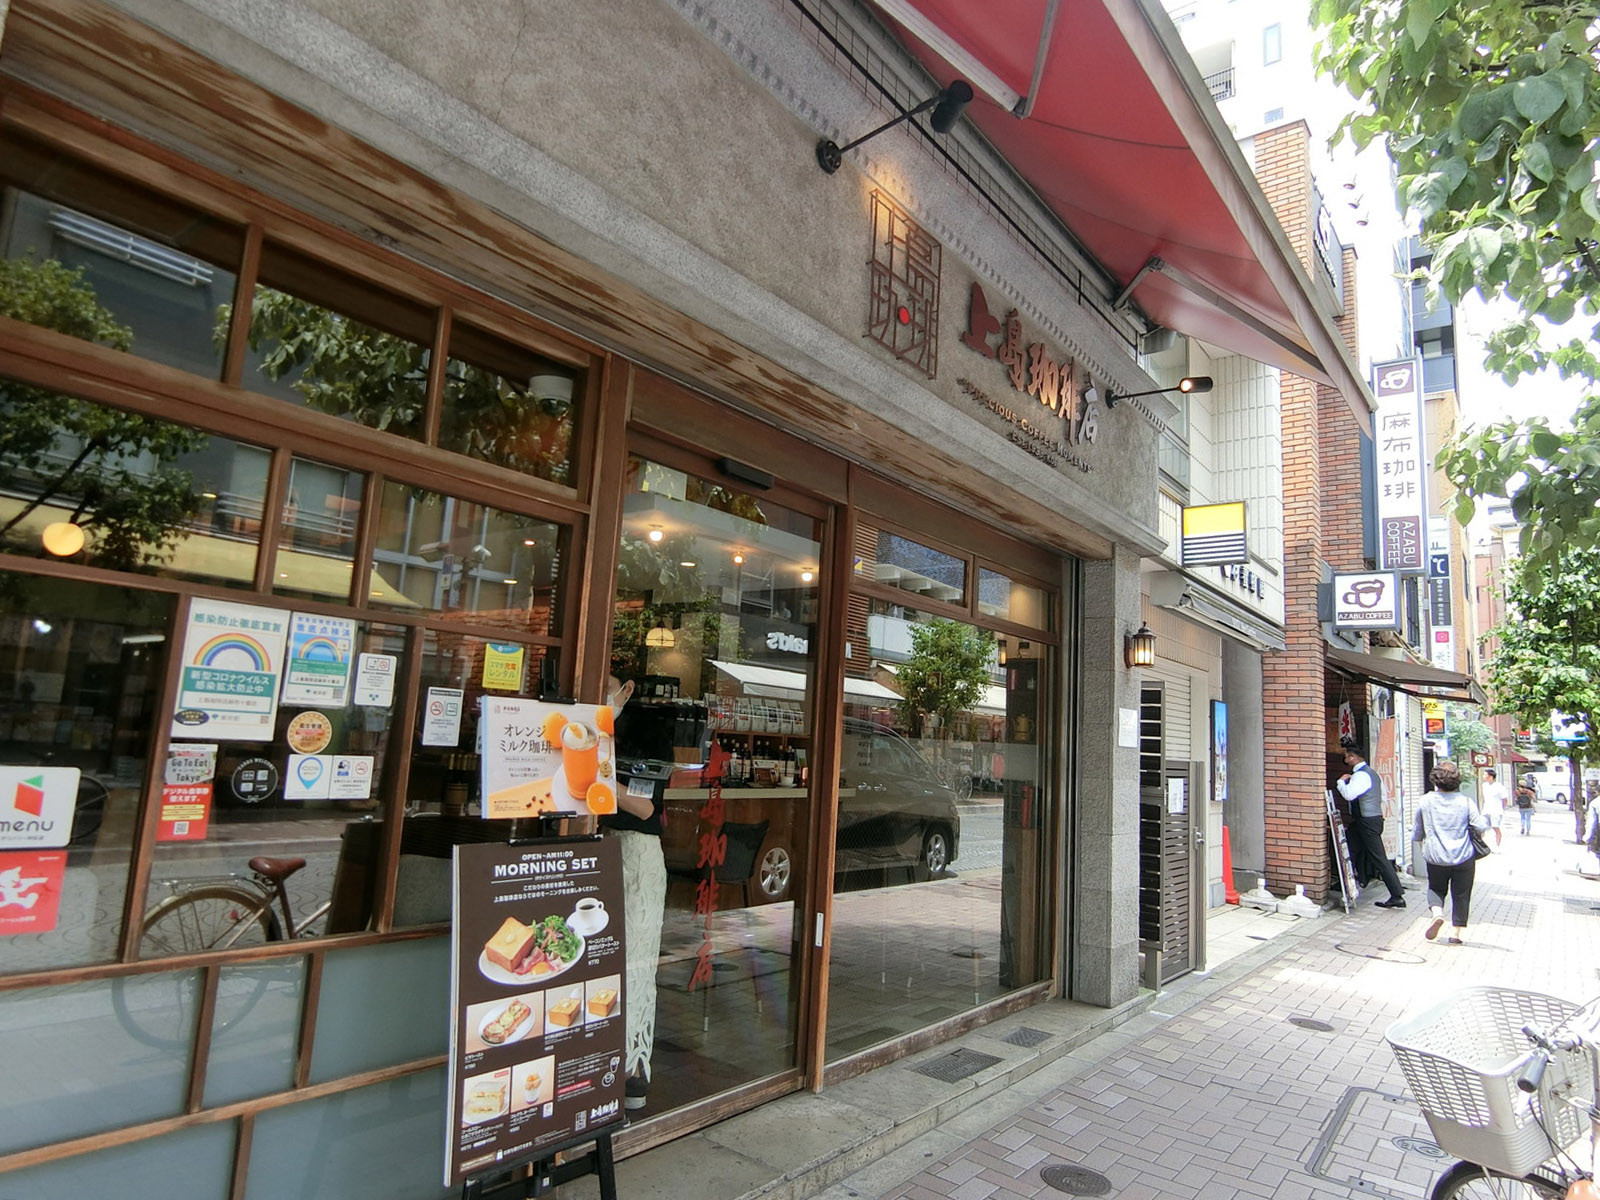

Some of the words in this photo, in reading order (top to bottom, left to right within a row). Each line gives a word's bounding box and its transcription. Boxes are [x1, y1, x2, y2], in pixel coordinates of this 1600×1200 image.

[1021, 417, 1055, 450] COFFEE
[1383, 411, 1415, 499] 麻布珈琲
[1386, 521, 1401, 565] COFFEE
[1401, 521, 1416, 564] AZABU
[1338, 612, 1364, 620] AZABU
[1365, 612, 1392, 620] COFFEE
[190, 669, 269, 685] 新型コロナウイルス
[194, 680, 264, 693] 感染拡大防止中
[503, 724, 546, 738] オレンジ
[499, 739, 553, 755] ミルク珈琲
[171, 758, 183, 767] Go
[184, 758, 193, 767] To
[194, 759, 208, 768] Eat
[176, 773, 201, 783] Tokyo
[0, 819, 54, 832] menu
[494, 860, 567, 878] MORNING
[571, 857, 598, 870] SET
